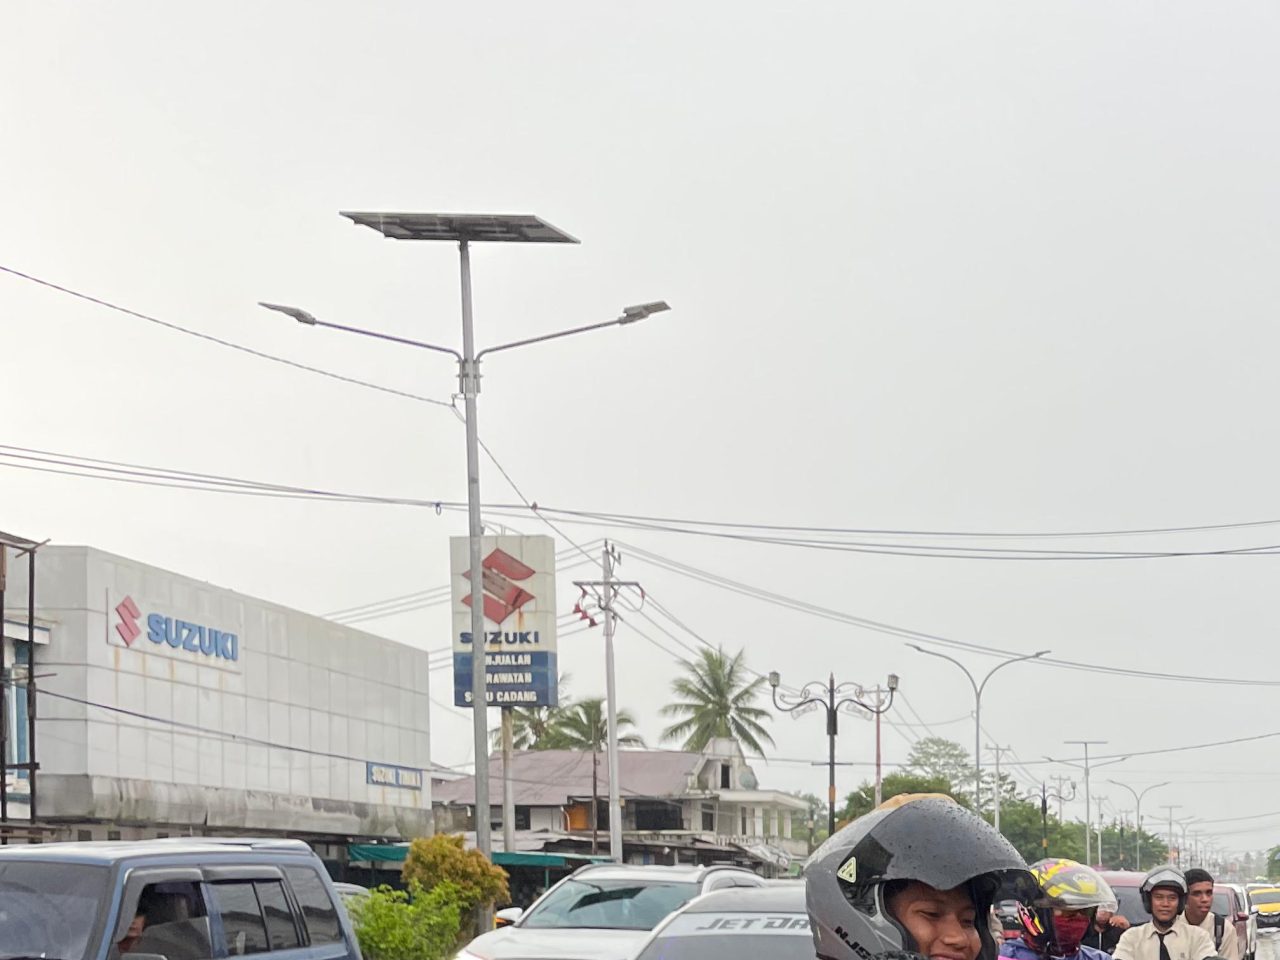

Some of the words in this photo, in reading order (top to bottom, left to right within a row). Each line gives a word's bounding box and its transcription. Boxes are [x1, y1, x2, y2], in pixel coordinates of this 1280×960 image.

[147, 612, 238, 661] SUZUKI
[459, 631, 539, 644] SZUKI
[484, 654, 532, 666] NJUALAN
[485, 672, 533, 684] RAWATAN
[464, 691, 494, 703] SU
[496, 691, 538, 703] CADANG
[696, 917, 760, 931] JET
[762, 917, 811, 930] DA
